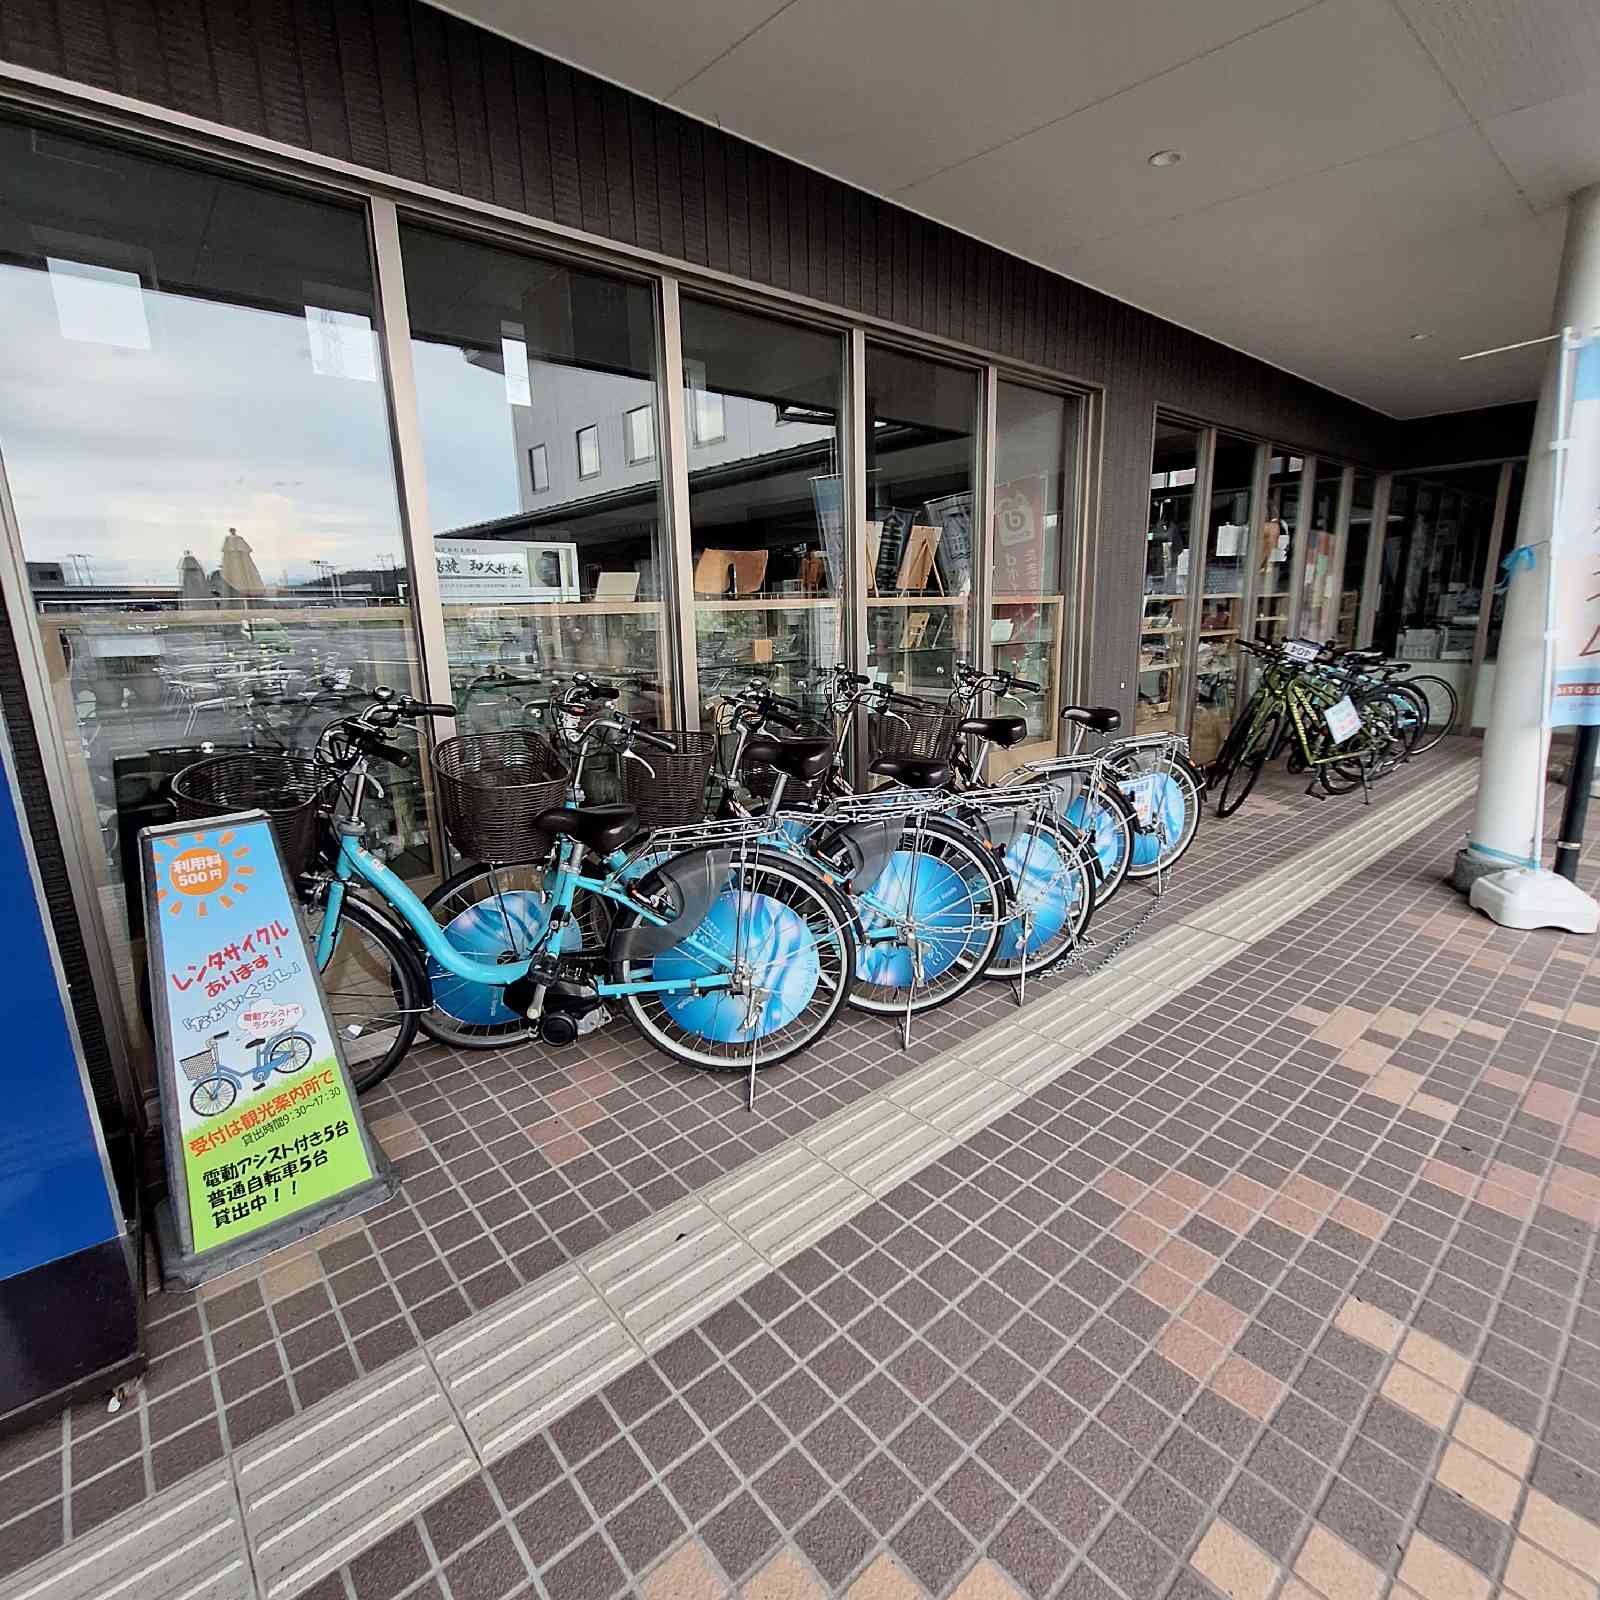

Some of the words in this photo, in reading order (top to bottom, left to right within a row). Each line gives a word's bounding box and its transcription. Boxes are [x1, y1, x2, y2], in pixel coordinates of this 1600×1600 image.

[172, 853, 223, 874] 利用料
[178, 870, 222, 887] 500円
[172, 920, 289, 992] レンタサイクル
[205, 946, 282, 998] あります！
[189, 1070, 335, 1157] 受付は観光案内所で
[203, 1120, 349, 1188] 電動アシスト付き5台
[207, 1150, 328, 1209] 普通自転車5台
[212, 1181, 298, 1229] 貸出中！！
